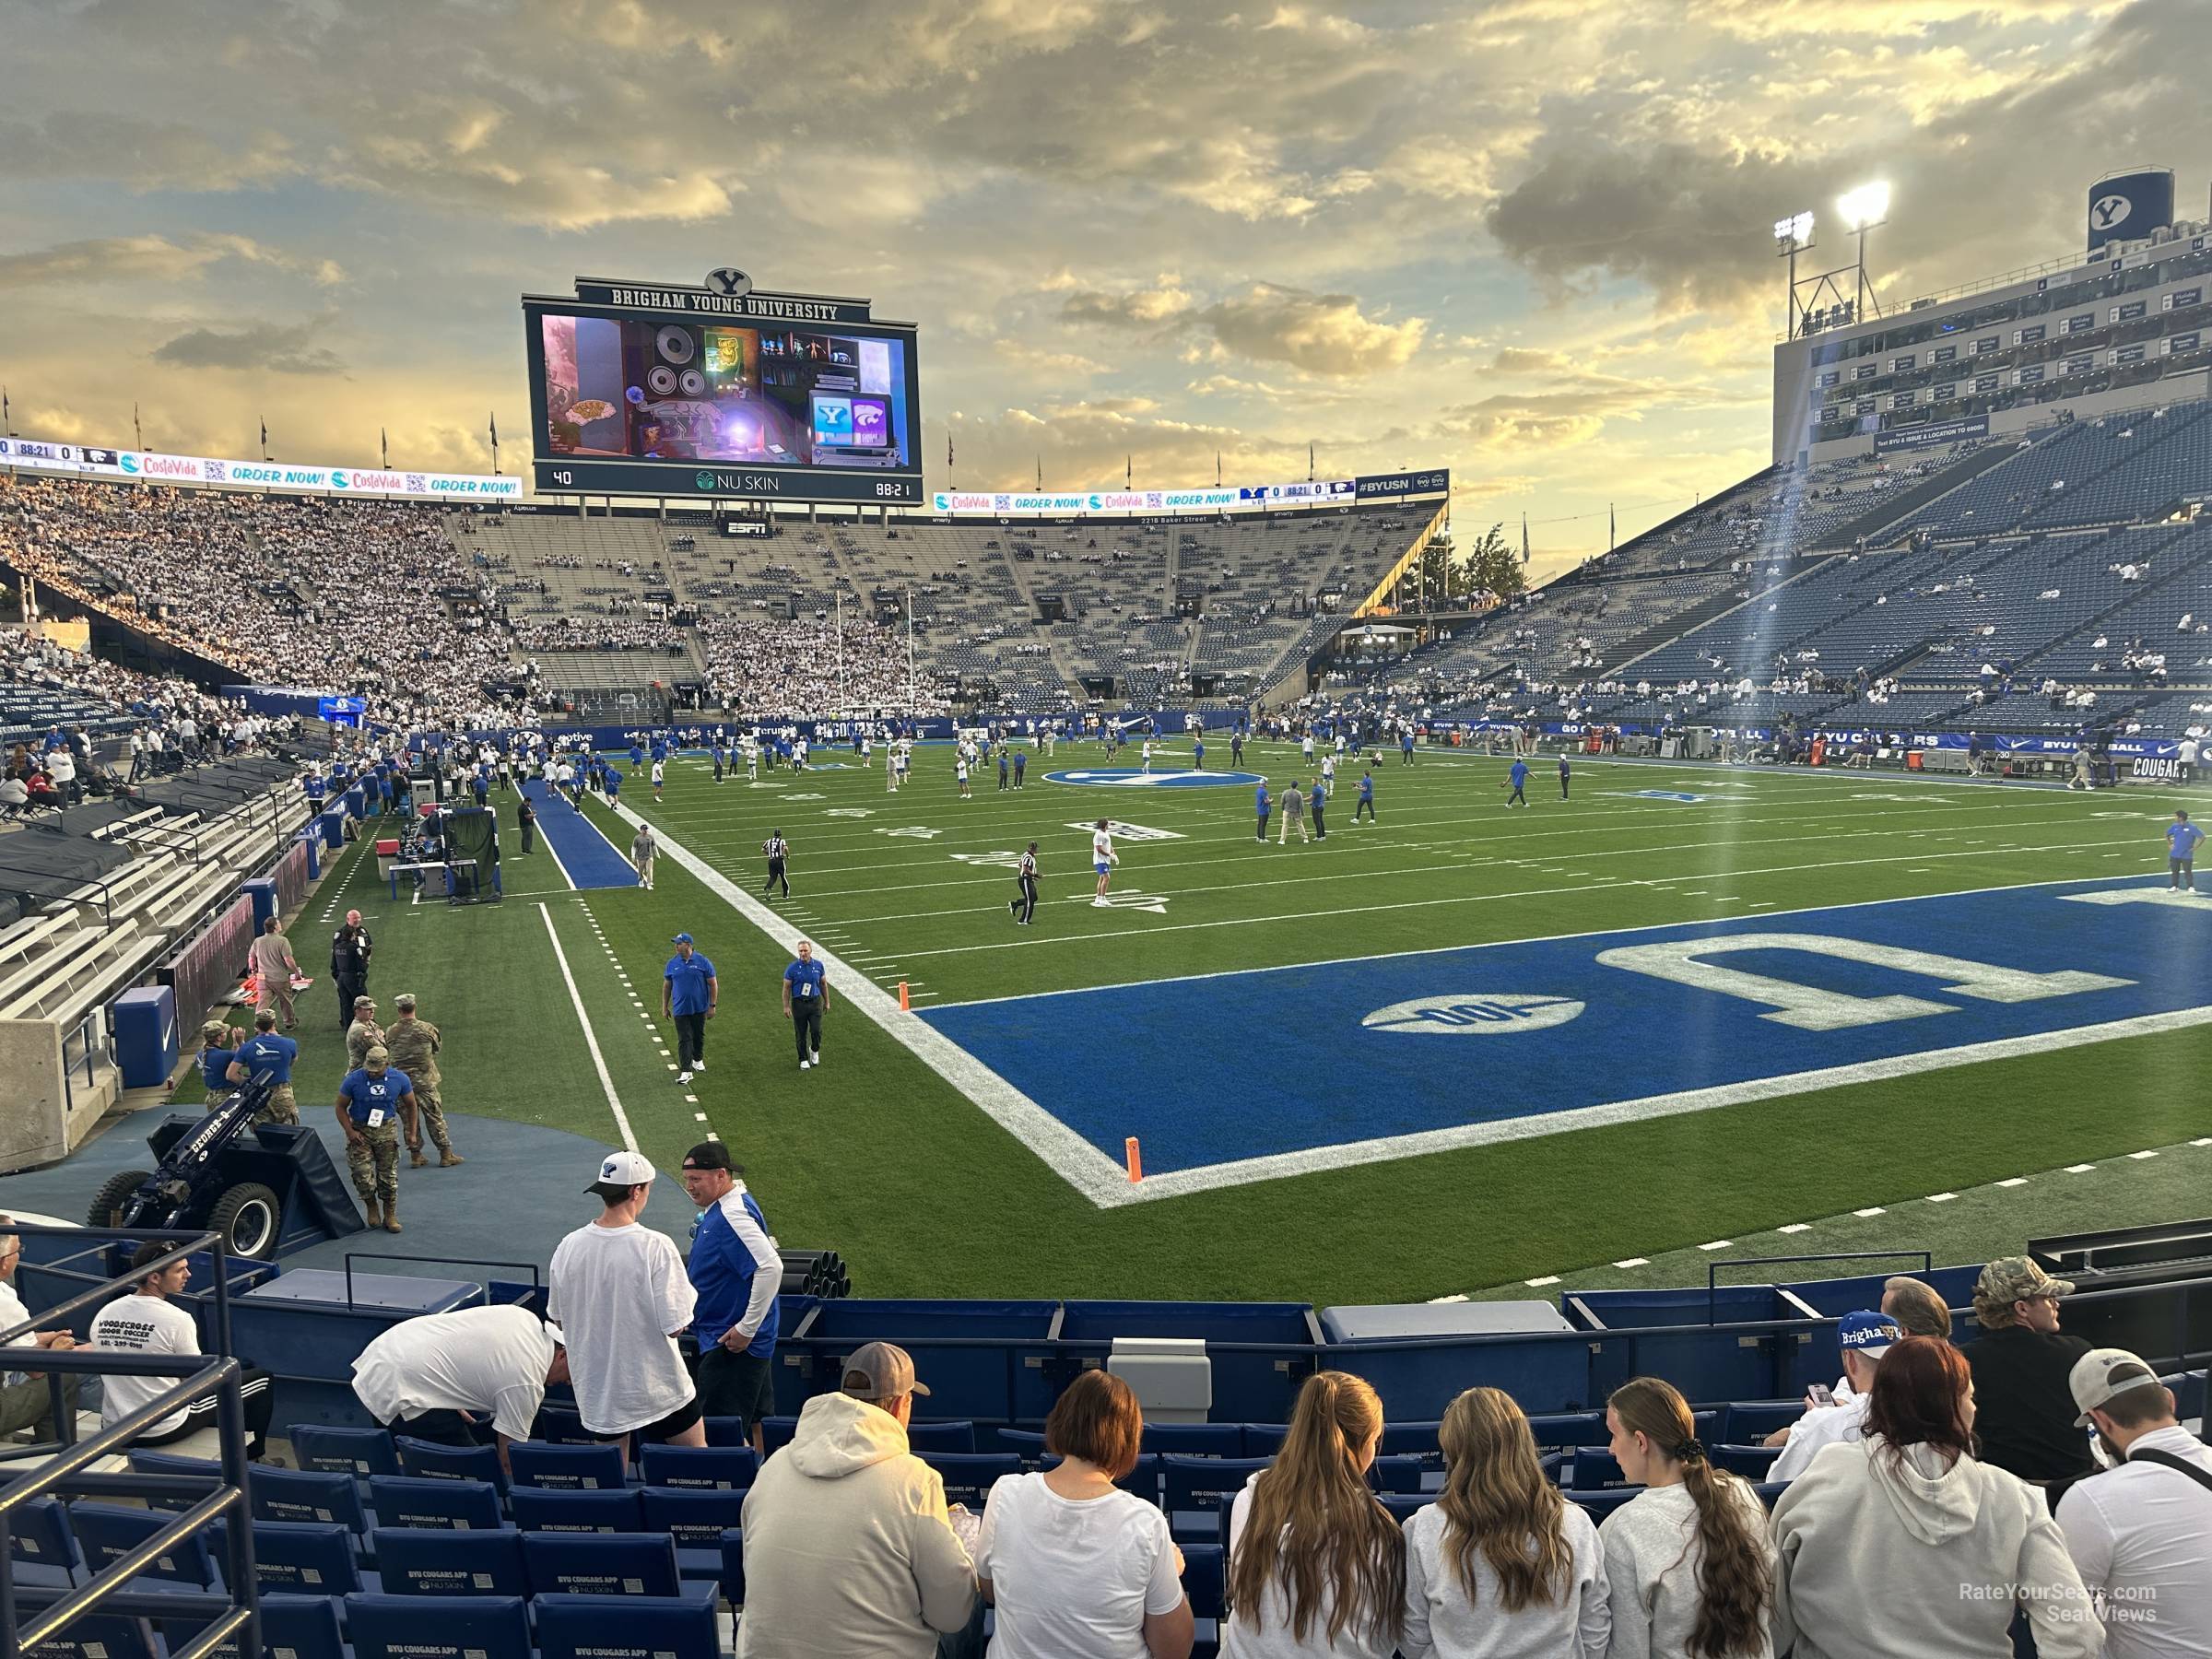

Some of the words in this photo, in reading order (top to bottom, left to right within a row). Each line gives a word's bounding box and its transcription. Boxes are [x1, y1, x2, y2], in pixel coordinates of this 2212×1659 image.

[612, 289, 686, 309] BRIGHAM
[692, 295, 742, 313] YOUNG
[747, 297, 838, 320] UNIVERSITY
[818, 406, 848, 424] Y
[1928, 429, 1957, 439] LOCATION
[20, 443, 49, 456] 88:21
[61, 447, 70, 460] 0
[143, 457, 197, 477] CostaVida
[232, 467, 281, 482] ORDER
[285, 471, 324, 485] NOW!
[353, 473, 402, 489] CostaVida
[553, 471, 571, 486] 40
[431, 479, 477, 492] ORDER
[479, 482, 516, 494] NOW!
[717, 475, 741, 490] NU
[745, 477, 780, 492] SKIN
[876, 483, 910, 497] 88:21
[1273, 488, 1279, 496] 0
[1288, 487, 1307, 496] 88:21
[1315, 484, 1322, 493] 0
[1359, 478, 1409, 492] #BYUSN
[194, 489, 221, 499] smarty
[1106, 494, 1143, 507] CostaVida
[1166, 495, 1203, 506] ORDER
[1206, 493, 1235, 504] NOW!
[952, 496, 990, 509] CostaVida
[1015, 499, 1052, 509] ORDER
[1054, 498, 1084, 508] NOW!
[728, 523, 766, 535] ESPN
[2042, 740, 2071, 748] BYU
[191, 1118, 222, 1153] GEORGE
[602, 1162, 617, 1178] Y
[124, 1329, 149, 1337] SOCCER
[387, 1644, 404, 1653] BYU
[404, 1645, 441, 1654] COUGARS
[575, 1647, 592, 1655] BYU
[593, 1648, 630, 1656] COUGARS
